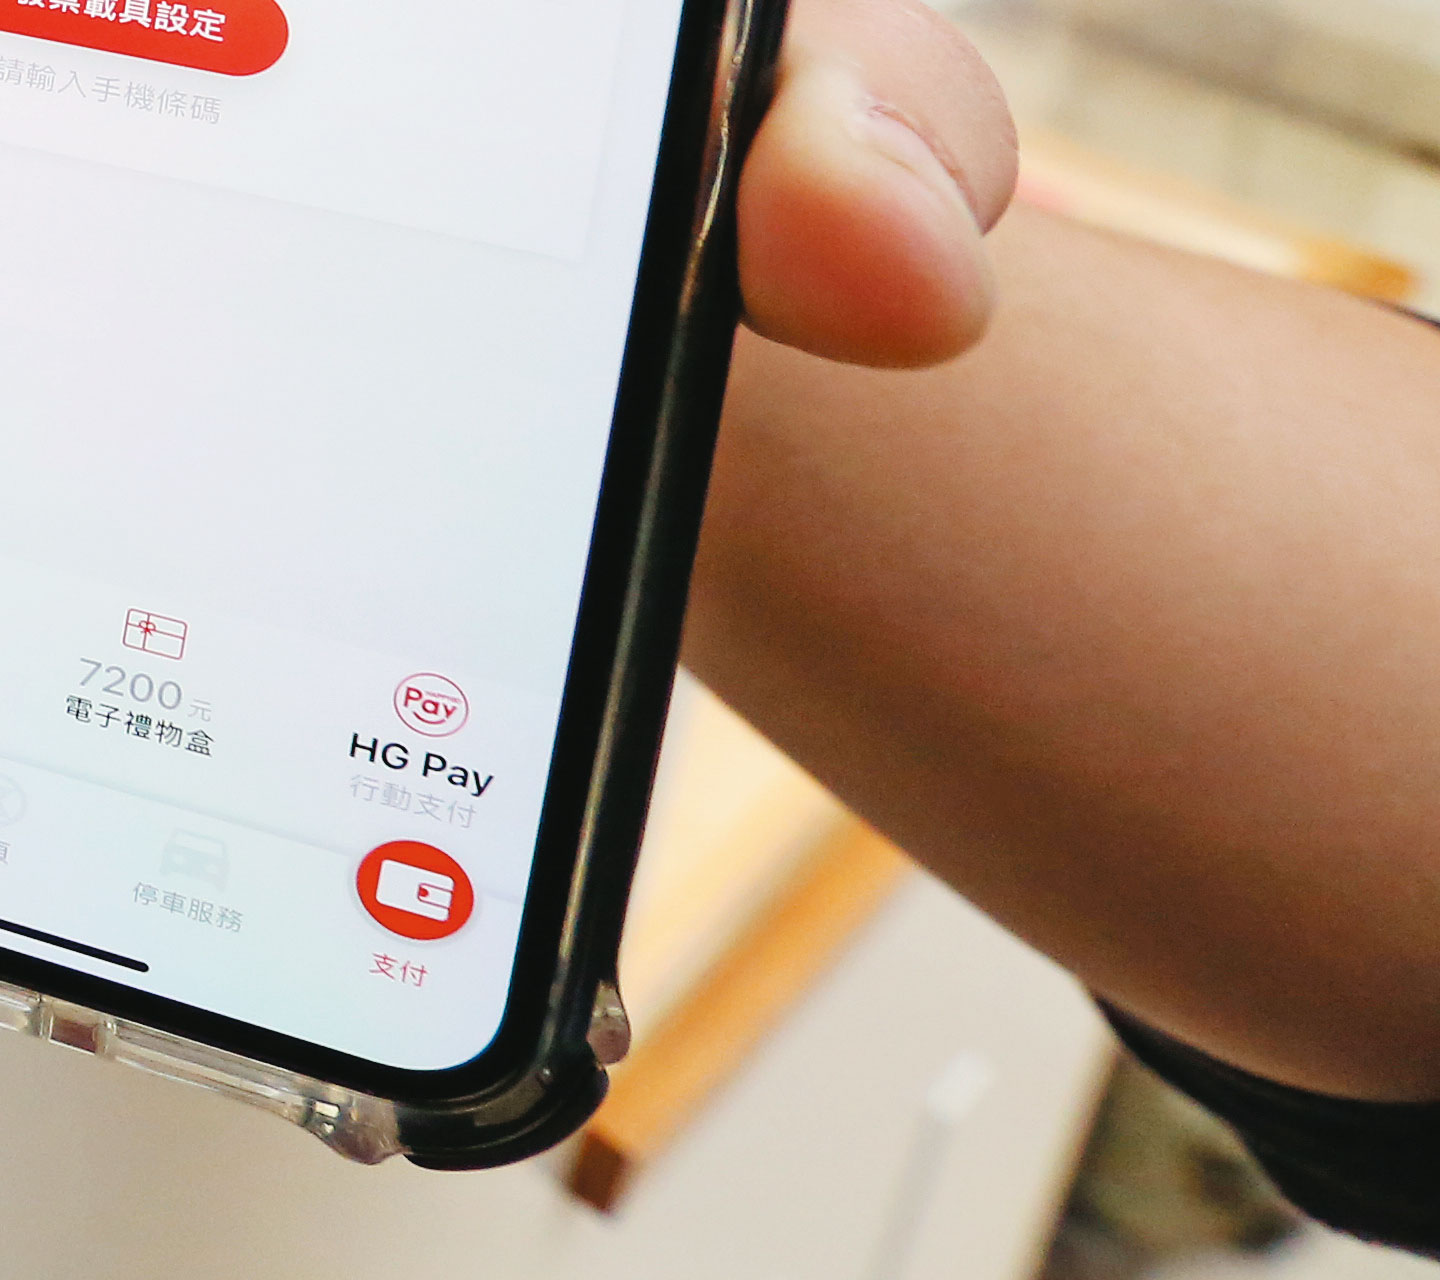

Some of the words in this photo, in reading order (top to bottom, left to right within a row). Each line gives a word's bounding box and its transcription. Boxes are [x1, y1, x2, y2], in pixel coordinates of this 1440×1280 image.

[77, 657, 182, 711] 7200
[187, 698, 213, 722] 元
[404, 686, 457, 719] Pay
[65, 694, 215, 758] 電子禮物盒
[349, 732, 409, 770] HG
[422, 751, 495, 798] Pay
[350, 773, 477, 830] 行動支付
[132, 881, 244, 934] 停車服務
[369, 952, 429, 988] 支付
